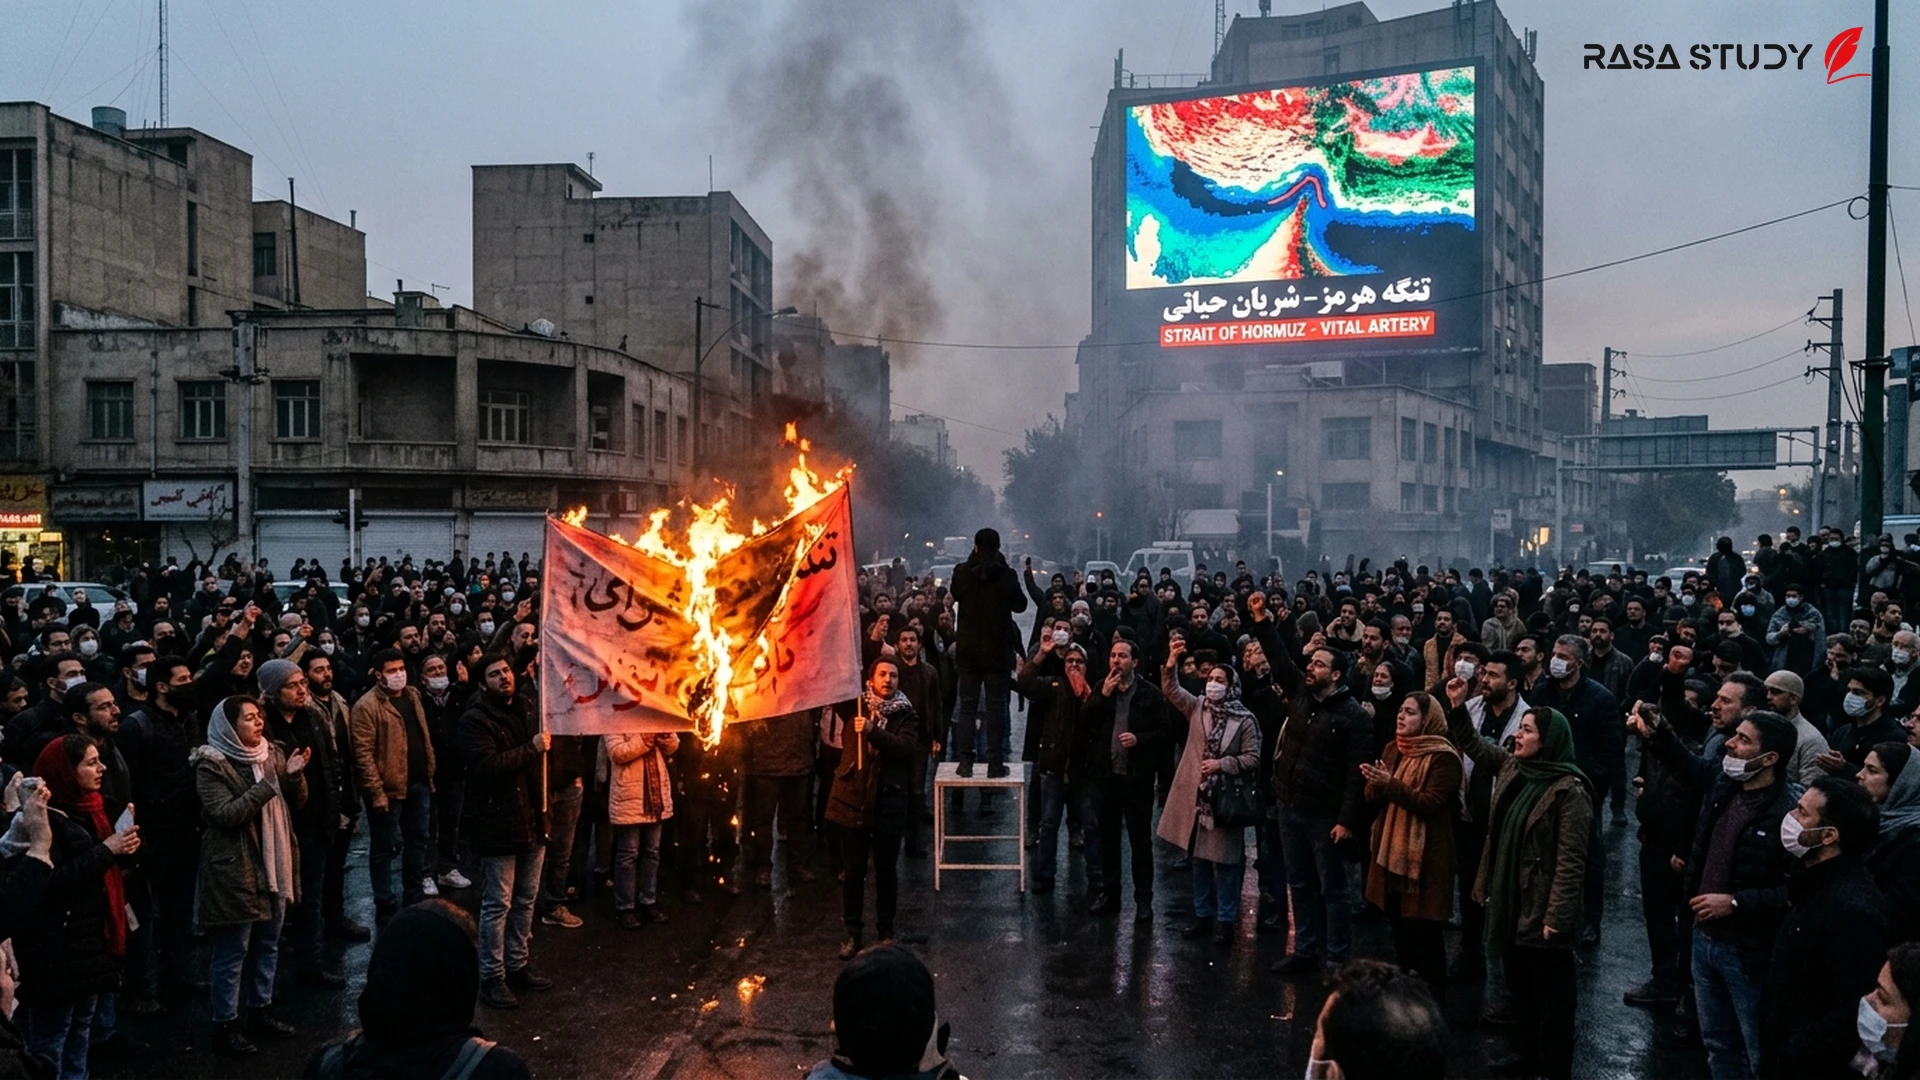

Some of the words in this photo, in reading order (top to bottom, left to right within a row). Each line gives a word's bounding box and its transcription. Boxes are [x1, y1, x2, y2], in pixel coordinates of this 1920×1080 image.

[1232, 285, 1300, 318] شریان
[1317, 285, 1377, 314] هرمز
[1381, 277, 1432, 303] تنگه
[1163, 290, 1228, 322] حیاتی
[1164, 326, 1217, 343] STRAIT
[1218, 325, 1238, 341] OF
[1241, 322, 1307, 340] HORMUZ
[1319, 320, 1365, 336] VITAL
[1367, 316, 1431, 334] ARTERY
